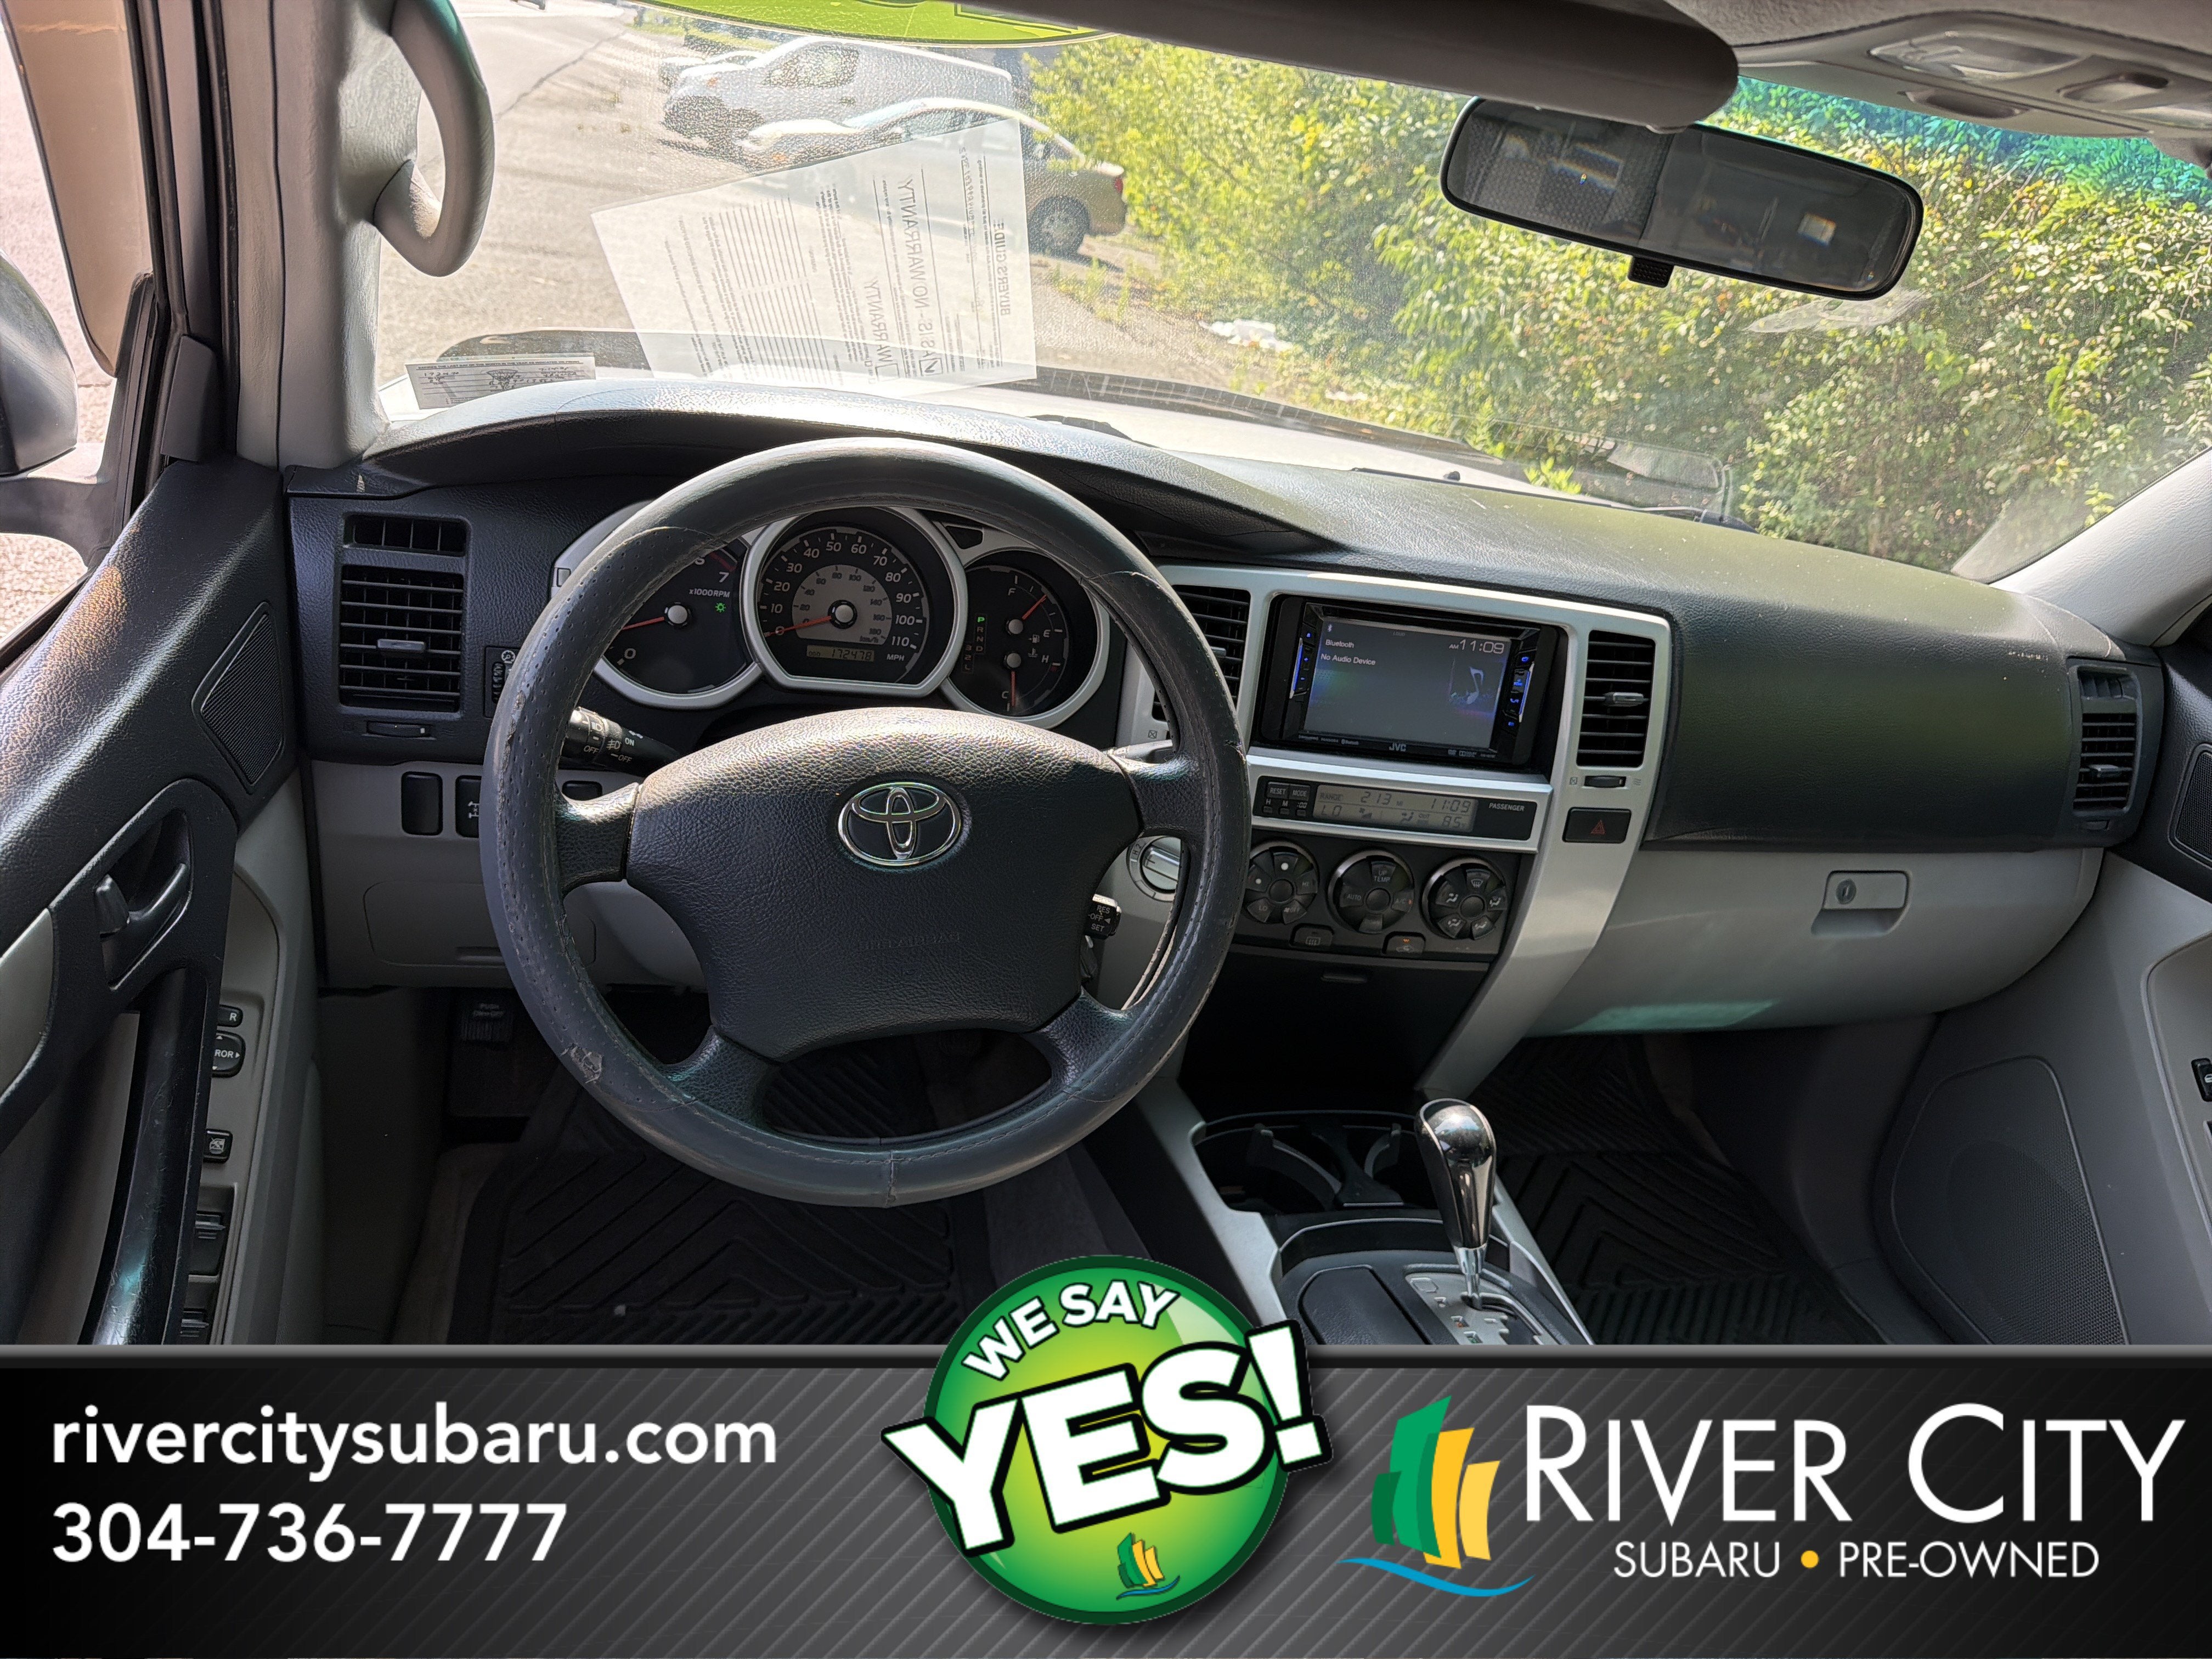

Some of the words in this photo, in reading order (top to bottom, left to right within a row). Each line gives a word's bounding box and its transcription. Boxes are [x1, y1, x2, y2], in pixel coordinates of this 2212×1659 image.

[826, 542, 842, 552] 50
[851, 544, 867, 554] 60
[803, 548, 820, 558] 40
[873, 556, 888, 566] 70
[786, 563, 803, 573] 30
[719, 571, 730, 583] 7
[885, 572, 901, 583] 80
[774, 582, 790, 592] 20
[1008, 588, 1017, 596] F
[895, 592, 912, 603] 90
[771, 604, 783, 613] 10
[895, 615, 915, 625] 100
[1043, 629, 1051, 638] E
[891, 636, 910, 647] 110
[1325, 639, 1355, 649] Bluetooth
[1460, 639, 1505, 654] 11:09
[624, 648, 636, 659] 0
[1041, 655, 1049, 663] H
[1321, 653, 1330, 661] No
[1332, 654, 1352, 663] Audio
[1353, 656, 1376, 666] Device
[1001, 691, 1009, 699] C
[624, 737, 635, 747] ON
[1389, 742, 1407, 752] JVC
[583, 745, 600, 754] OFF
[618, 754, 633, 763] OFF
[1431, 798, 1471, 814] 11:09
[1488, 802, 1525, 812] PASSENGER
[1097, 905, 1110, 914] RES
[1091, 923, 1105, 932] SET
[229, 1012, 237, 1022] R
